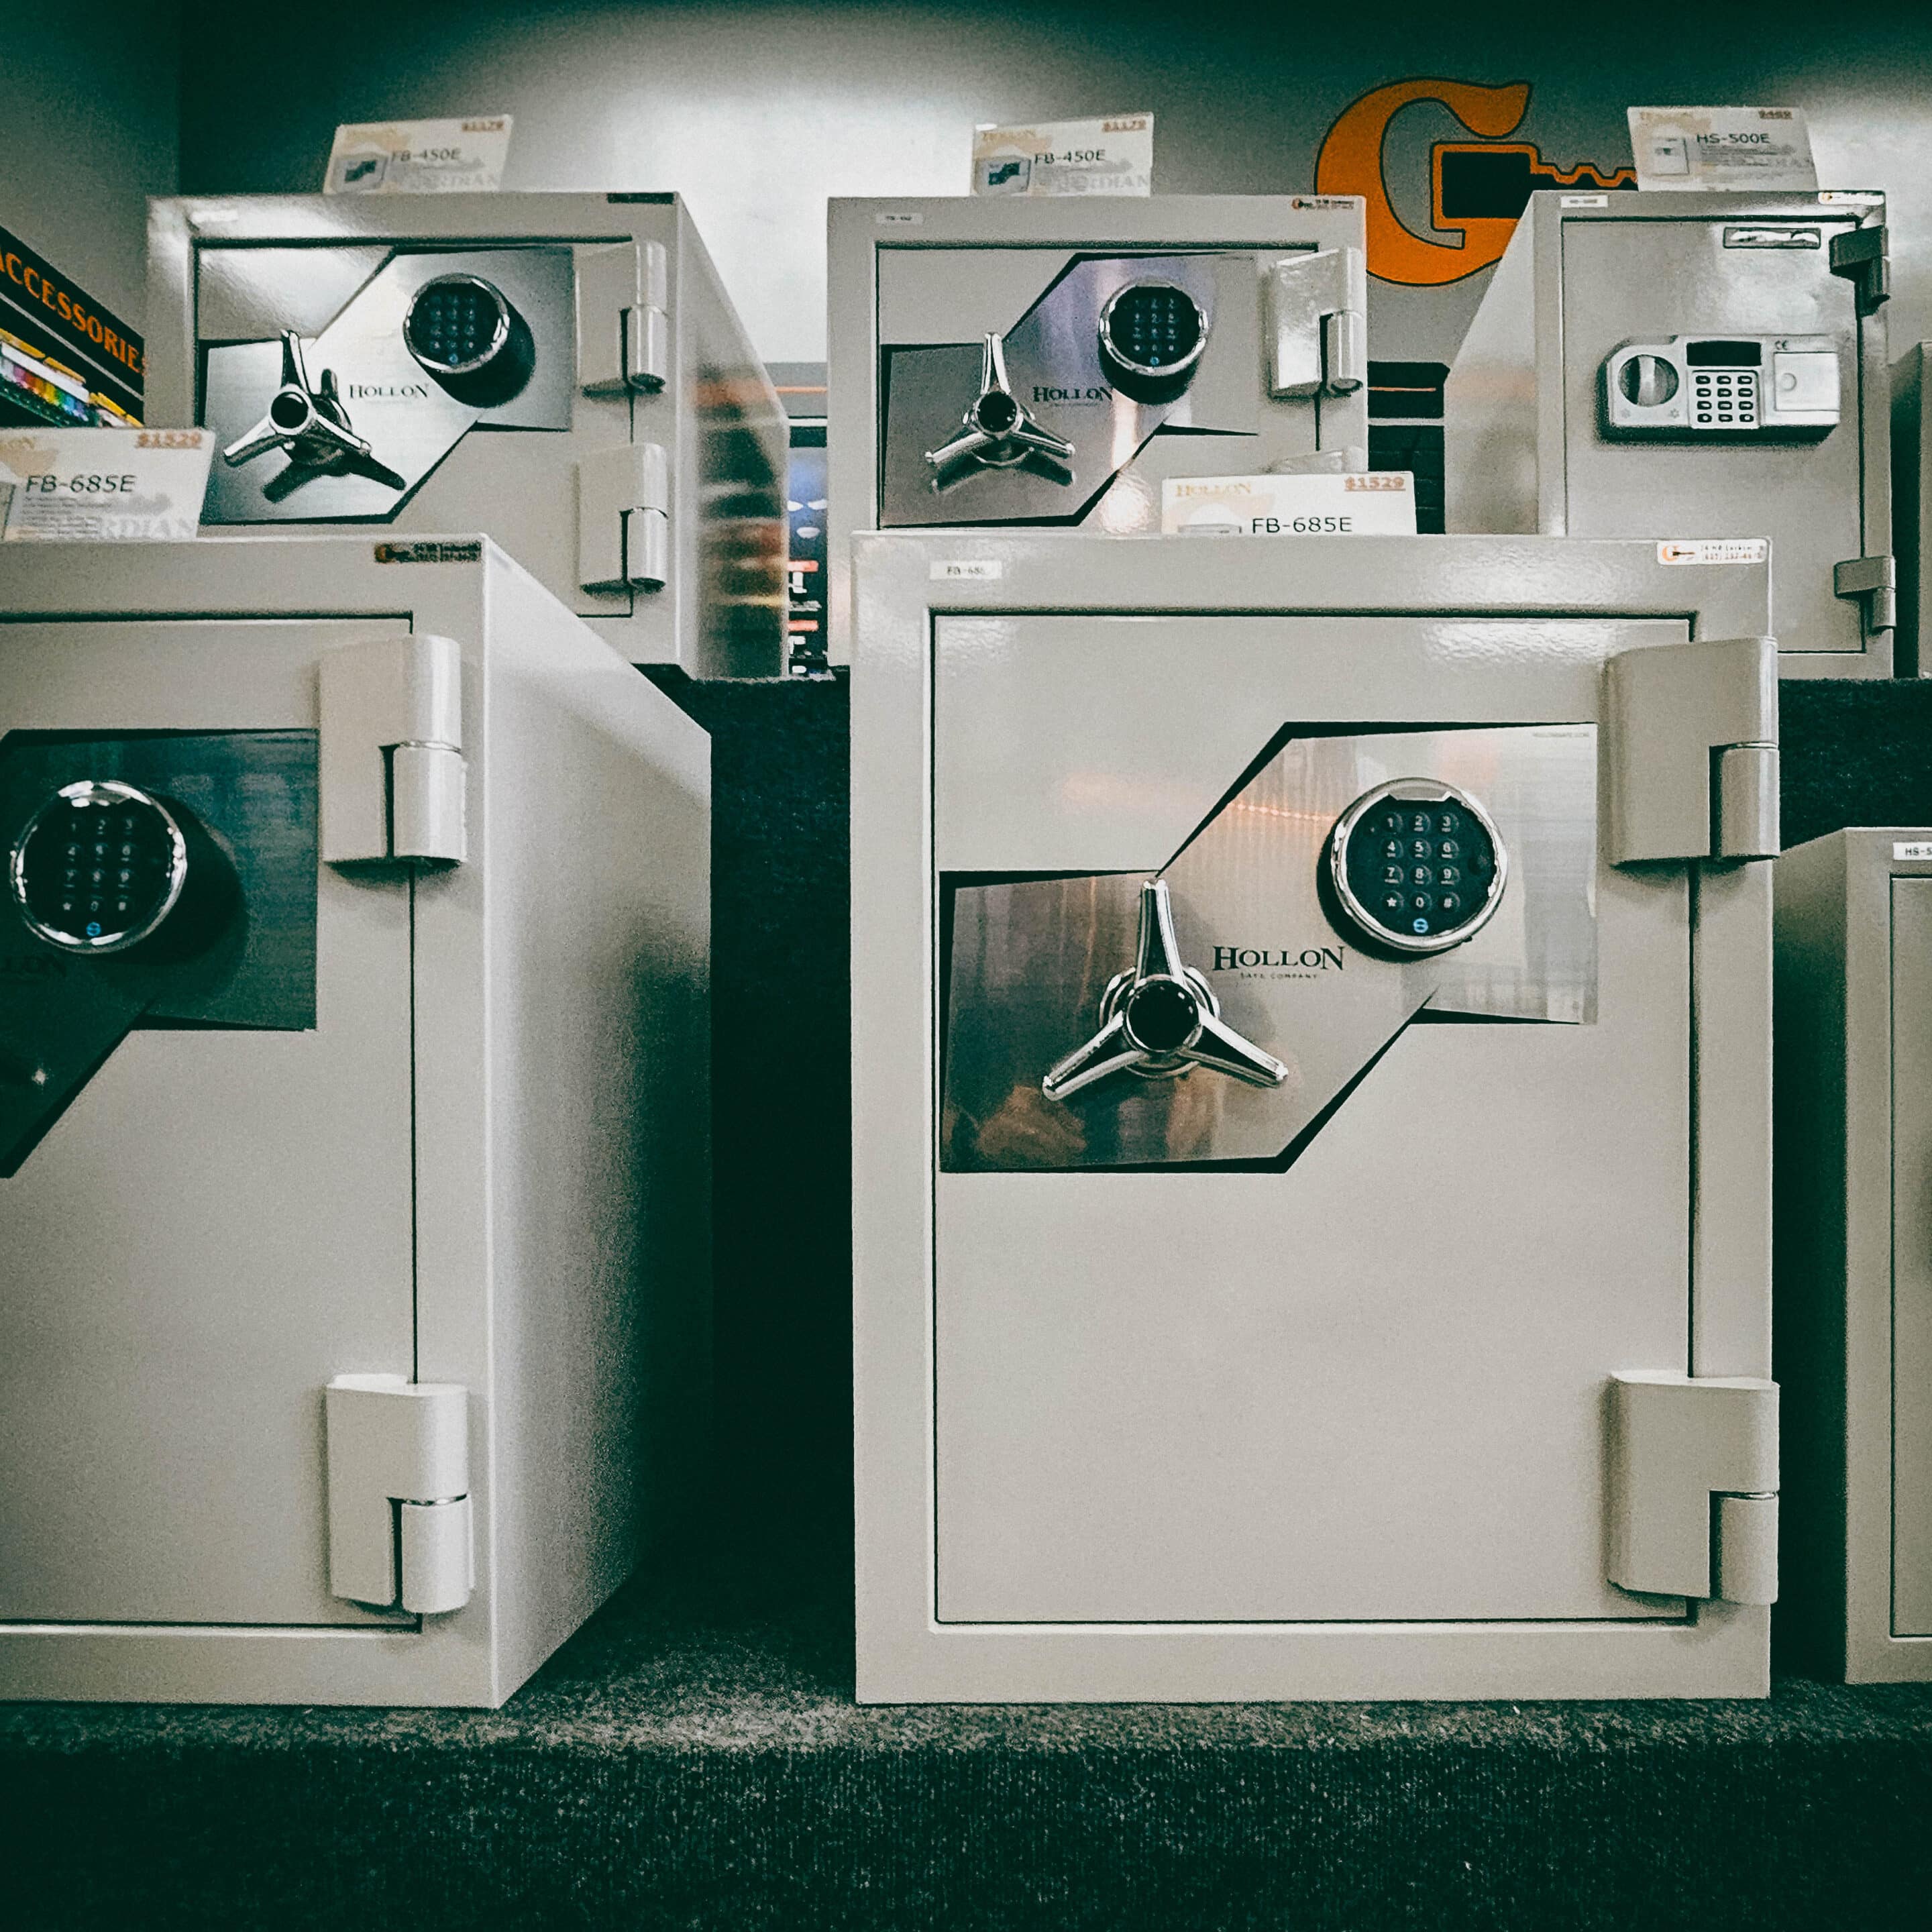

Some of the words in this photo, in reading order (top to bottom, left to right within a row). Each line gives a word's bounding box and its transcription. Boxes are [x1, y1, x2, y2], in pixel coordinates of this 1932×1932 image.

[1697, 133, 1771, 144] HS-500E
[1034, 149, 1106, 164] FB-450E
[348, 384, 428, 398] HOLLON
[1032, 385, 1113, 402] HOLLON
[25, 474, 136, 493] FB-685E
[1344, 476, 1405, 491] $1529
[1252, 517, 1353, 534] FB-685E
[1212, 945, 1345, 971] HOLLON
